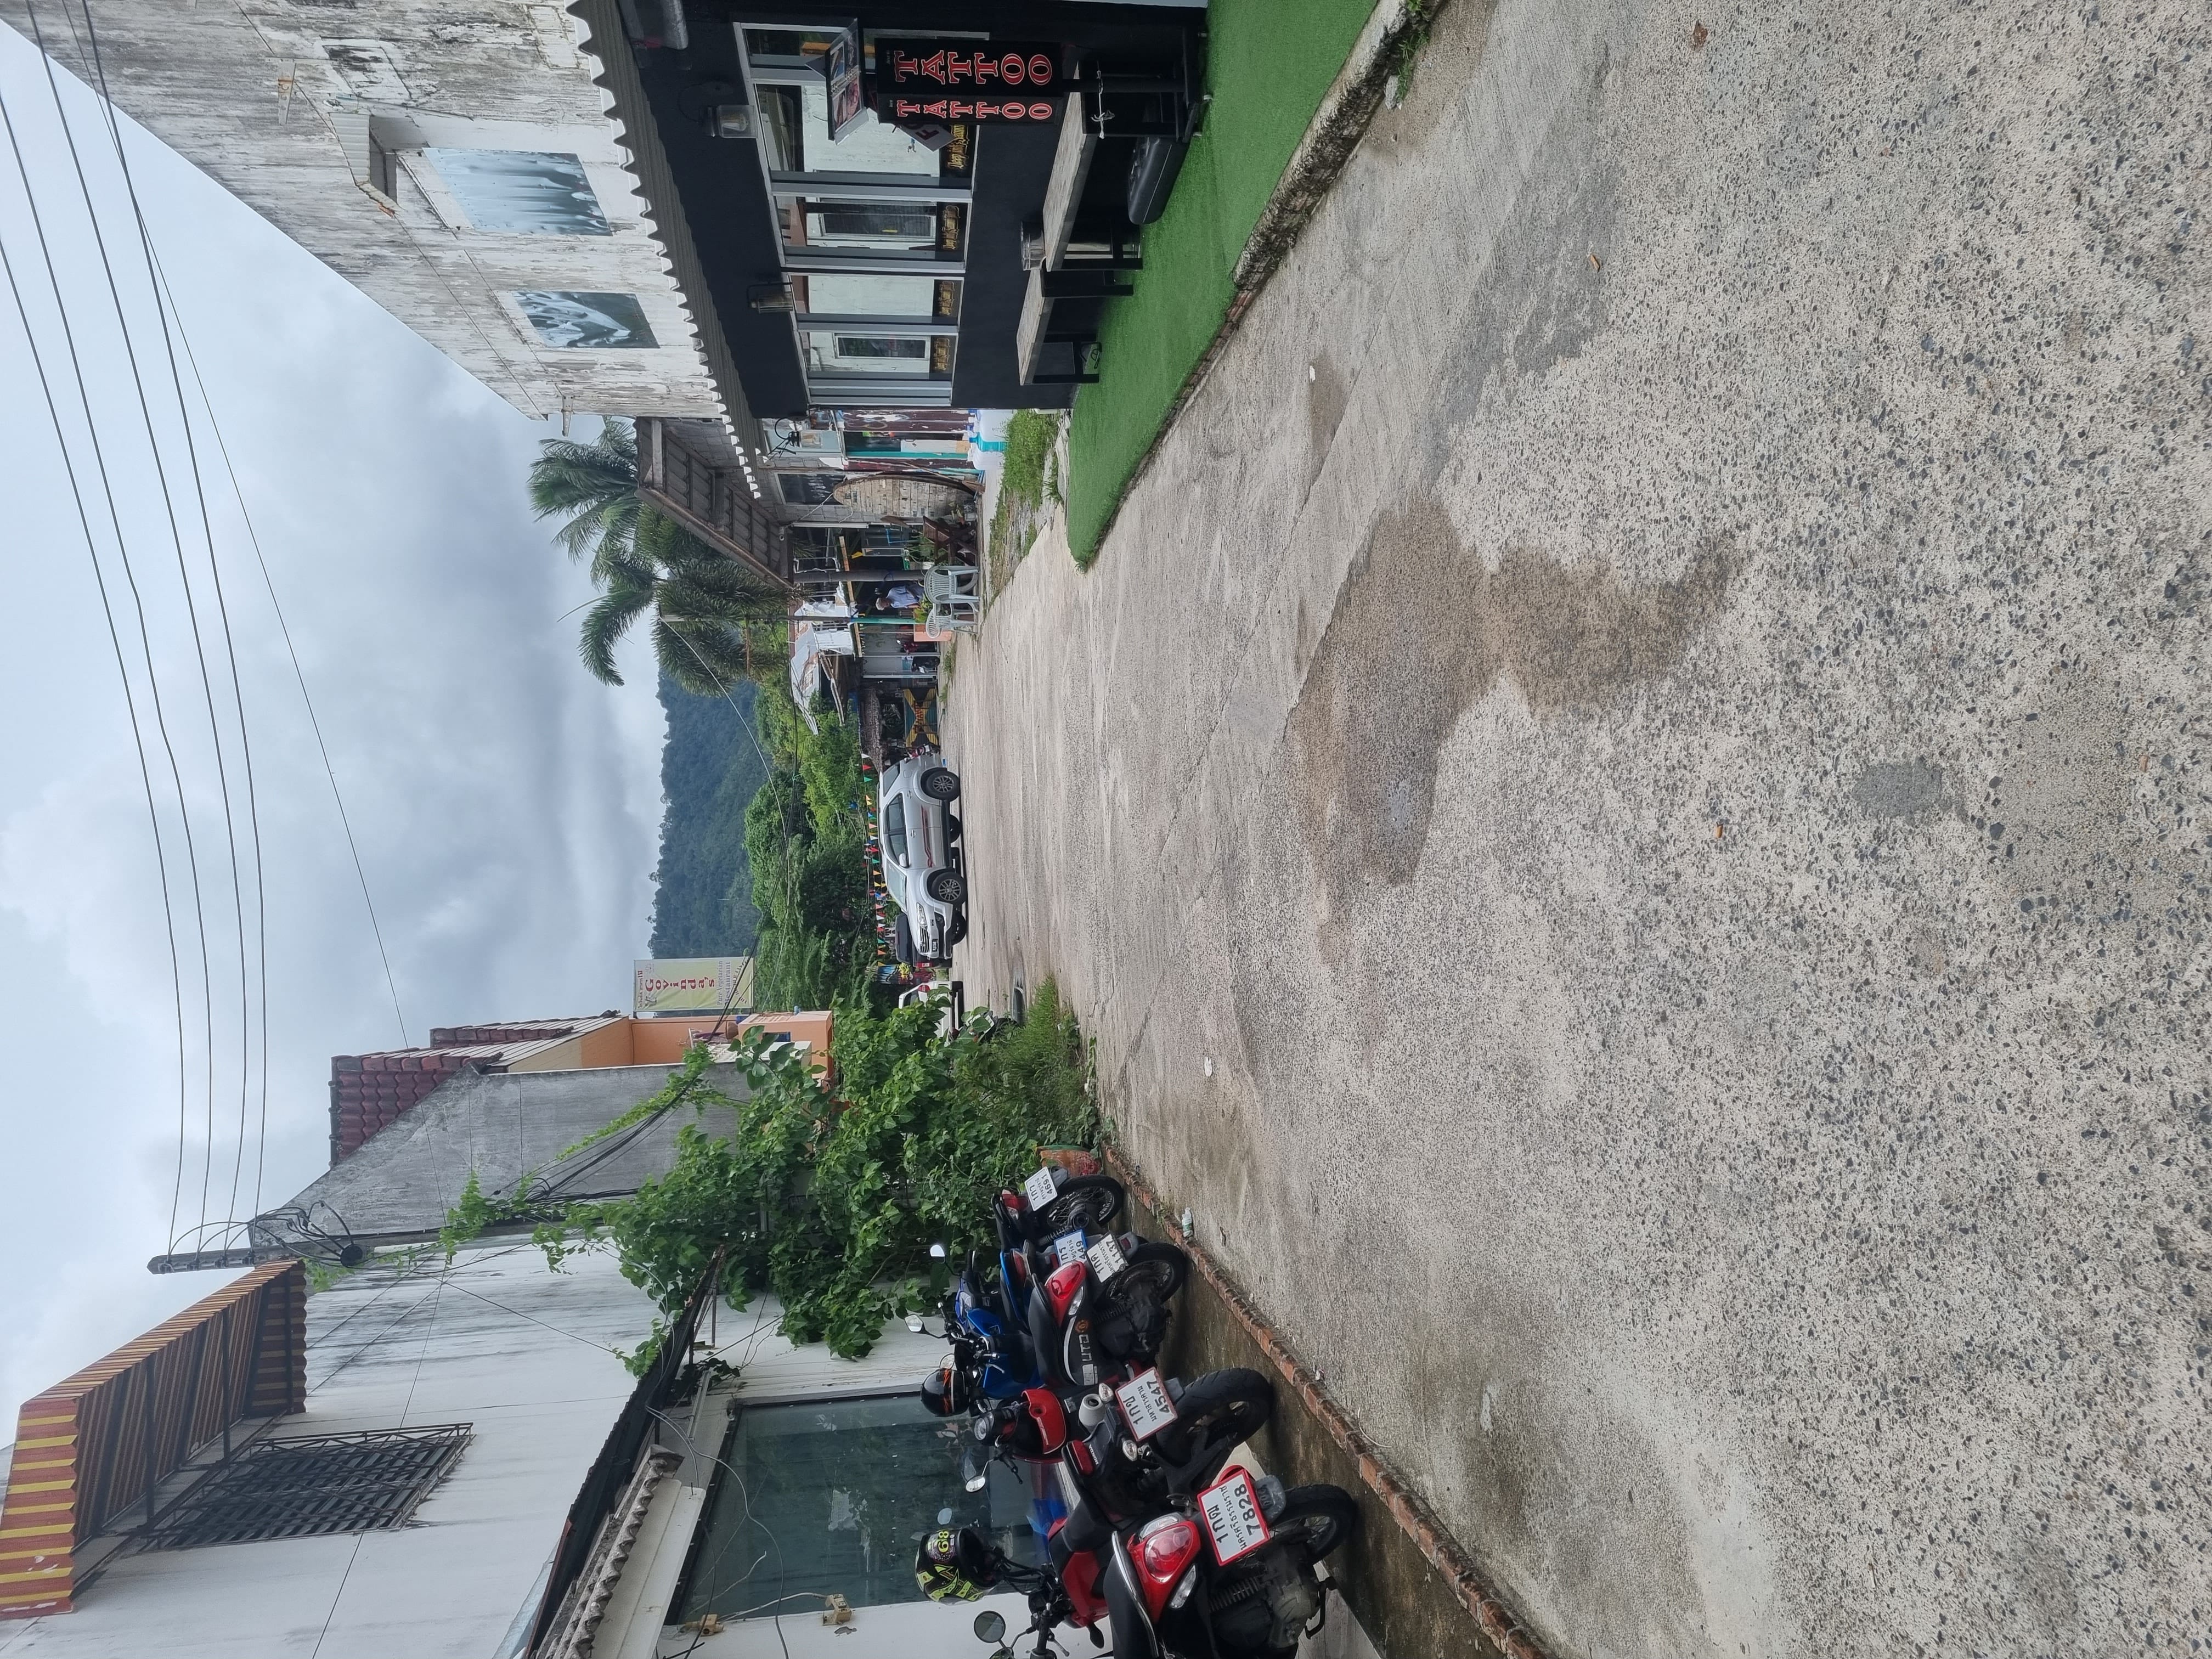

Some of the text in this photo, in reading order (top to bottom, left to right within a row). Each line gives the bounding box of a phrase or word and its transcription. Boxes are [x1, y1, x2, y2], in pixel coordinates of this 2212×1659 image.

[894, 50, 1052, 86] TATTOO
[896, 100, 1052, 120] TATTOO
[645, 977, 714, 992] Govinda's
[1041, 1173, 1053, 1195] 4691
[1106, 1240, 1122, 1263] 1137
[1137, 1386, 1158, 1422] มหาสารคาม
[1147, 1380, 1170, 1413] 4547
[1089, 1444, 1098, 1465] HONDA
[1219, 1485, 1248, 1550] นครศรีธรรมราช
[1234, 1483, 1261, 1536] 7828
